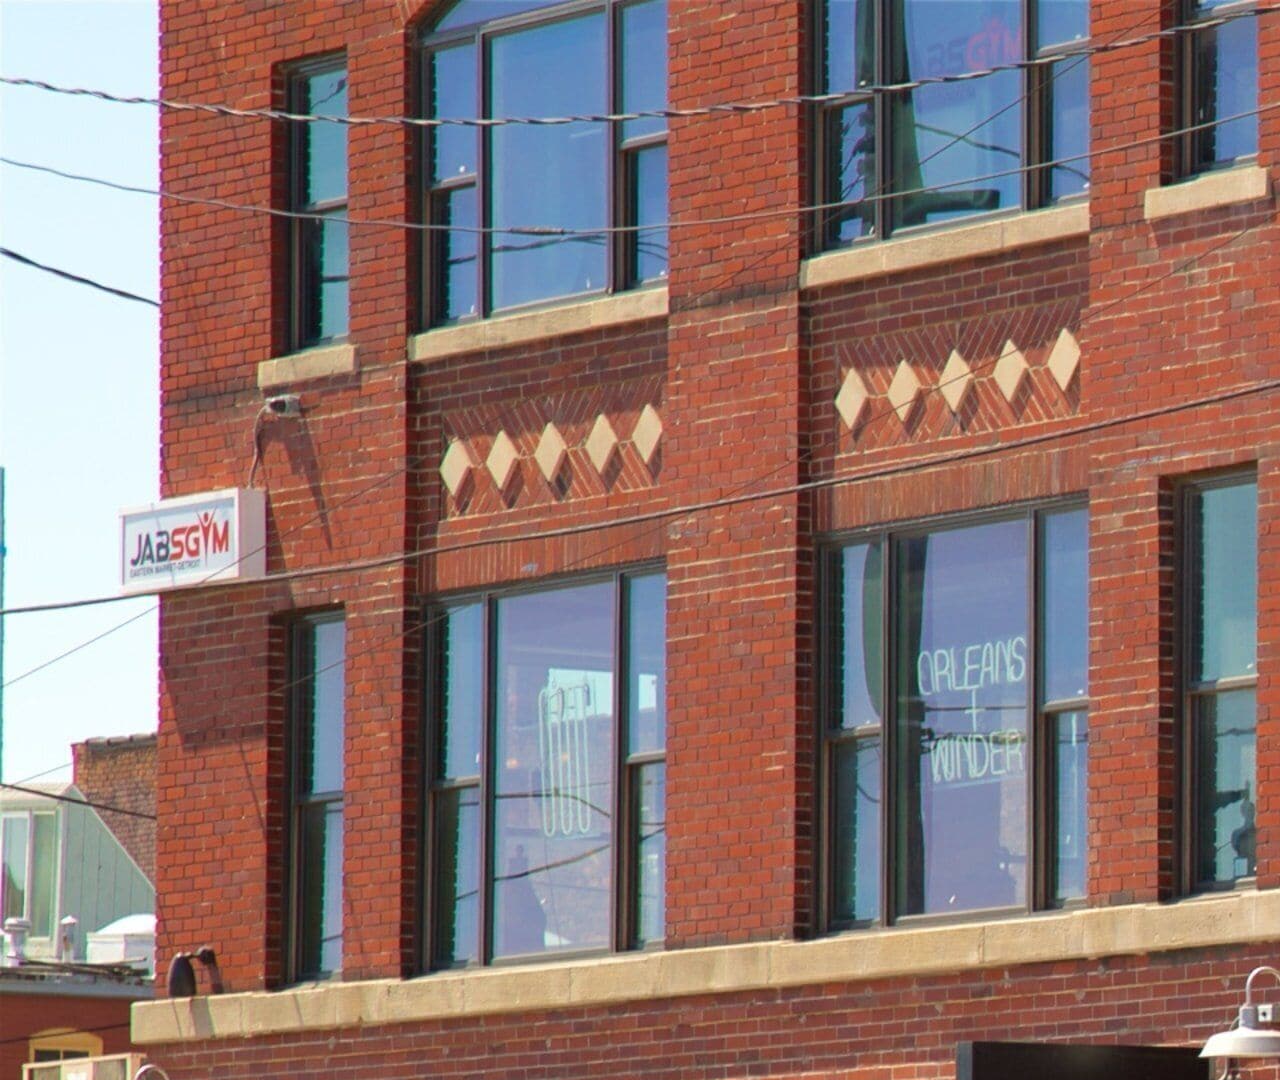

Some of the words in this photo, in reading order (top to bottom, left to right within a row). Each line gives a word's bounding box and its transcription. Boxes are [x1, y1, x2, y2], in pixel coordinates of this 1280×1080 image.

[130, 508, 229, 567] JABSGYM
[917, 636, 1027, 696] ORLEANS
[930, 728, 1025, 783] WINDER
